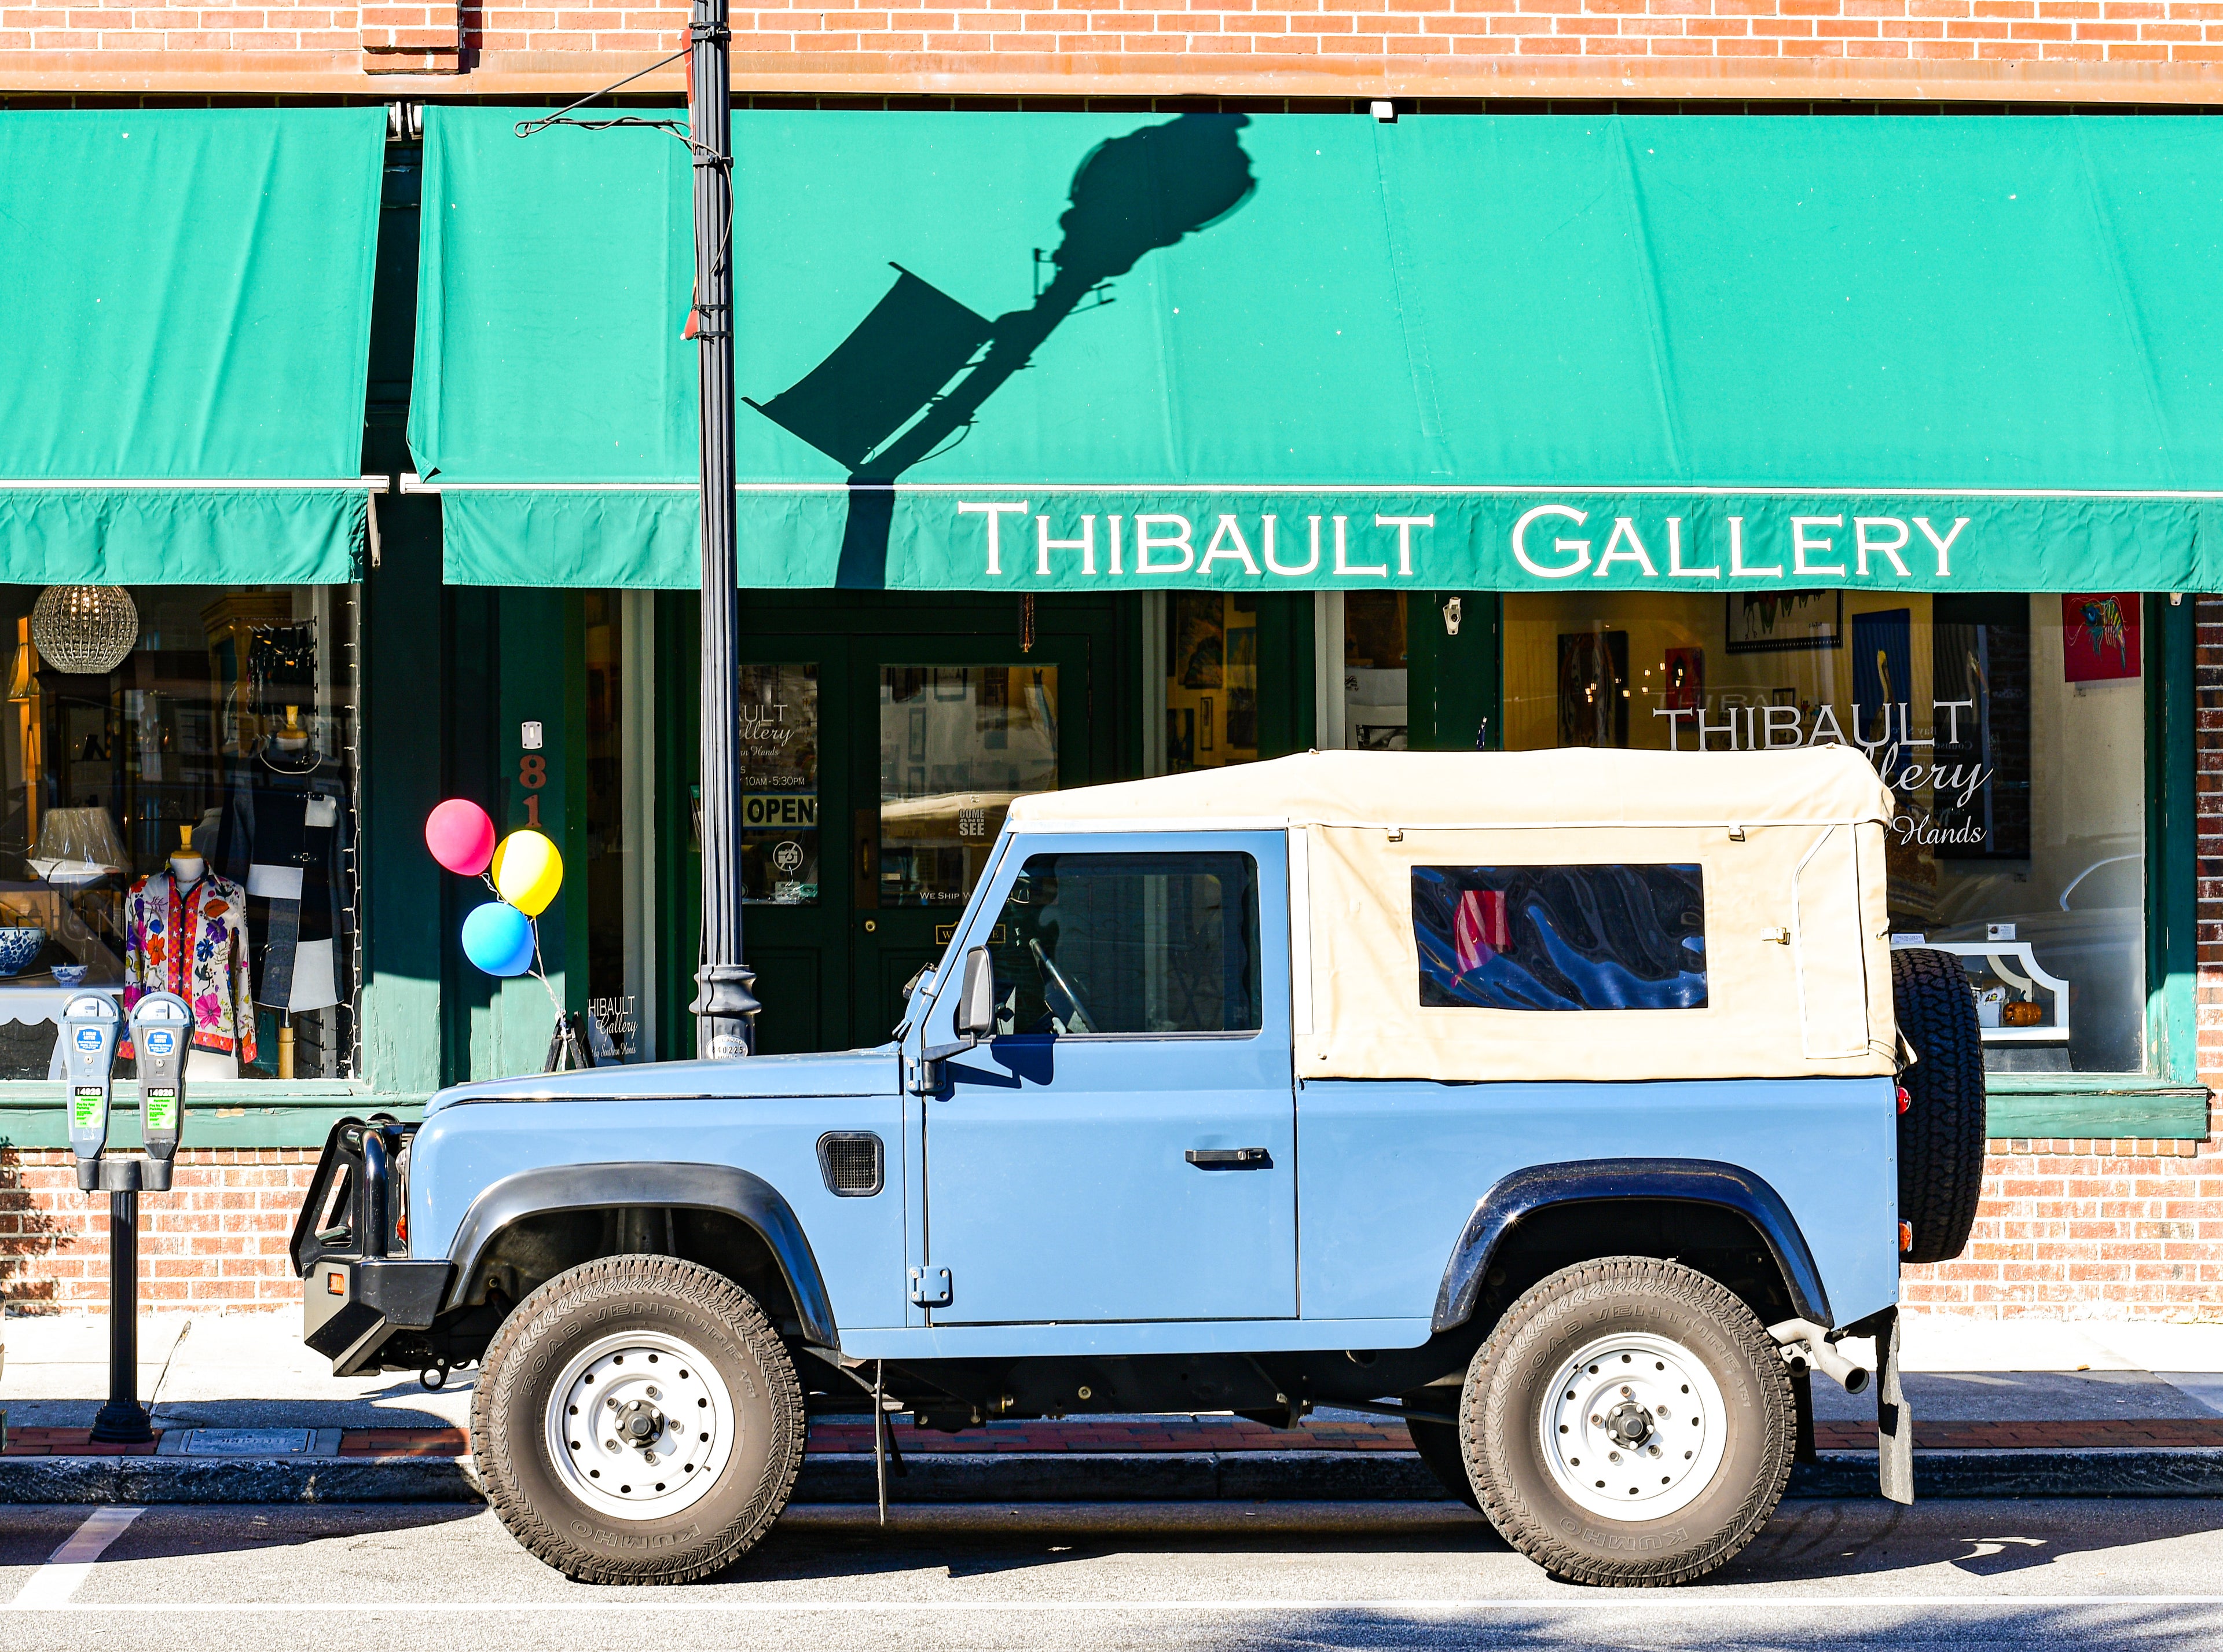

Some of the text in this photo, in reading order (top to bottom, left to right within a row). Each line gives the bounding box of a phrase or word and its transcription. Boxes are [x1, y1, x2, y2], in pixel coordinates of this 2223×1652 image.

[958, 500, 1970, 579] THIBAULT GALLERY
[739, 704, 788, 722] ULT
[1653, 699, 1973, 751] THIBAULT
[740, 719, 794, 747] llery
[747, 799, 814, 823] OPEN
[959, 809, 984, 818] COME
[959, 823, 984, 836] SEE
[1892, 816, 1986, 845] Hands
[588, 996, 635, 1017] HIBAULT
[595, 1013, 638, 1042] Gallery
[520, 1321, 583, 1396] ROAD
[585, 1301, 745, 1365] VENTURE
[1519, 1304, 1752, 1408] ROAD VENTURE AT51
[570, 1520, 702, 1548] KUMHO
[1560, 1516, 1689, 1551] KUMHO
